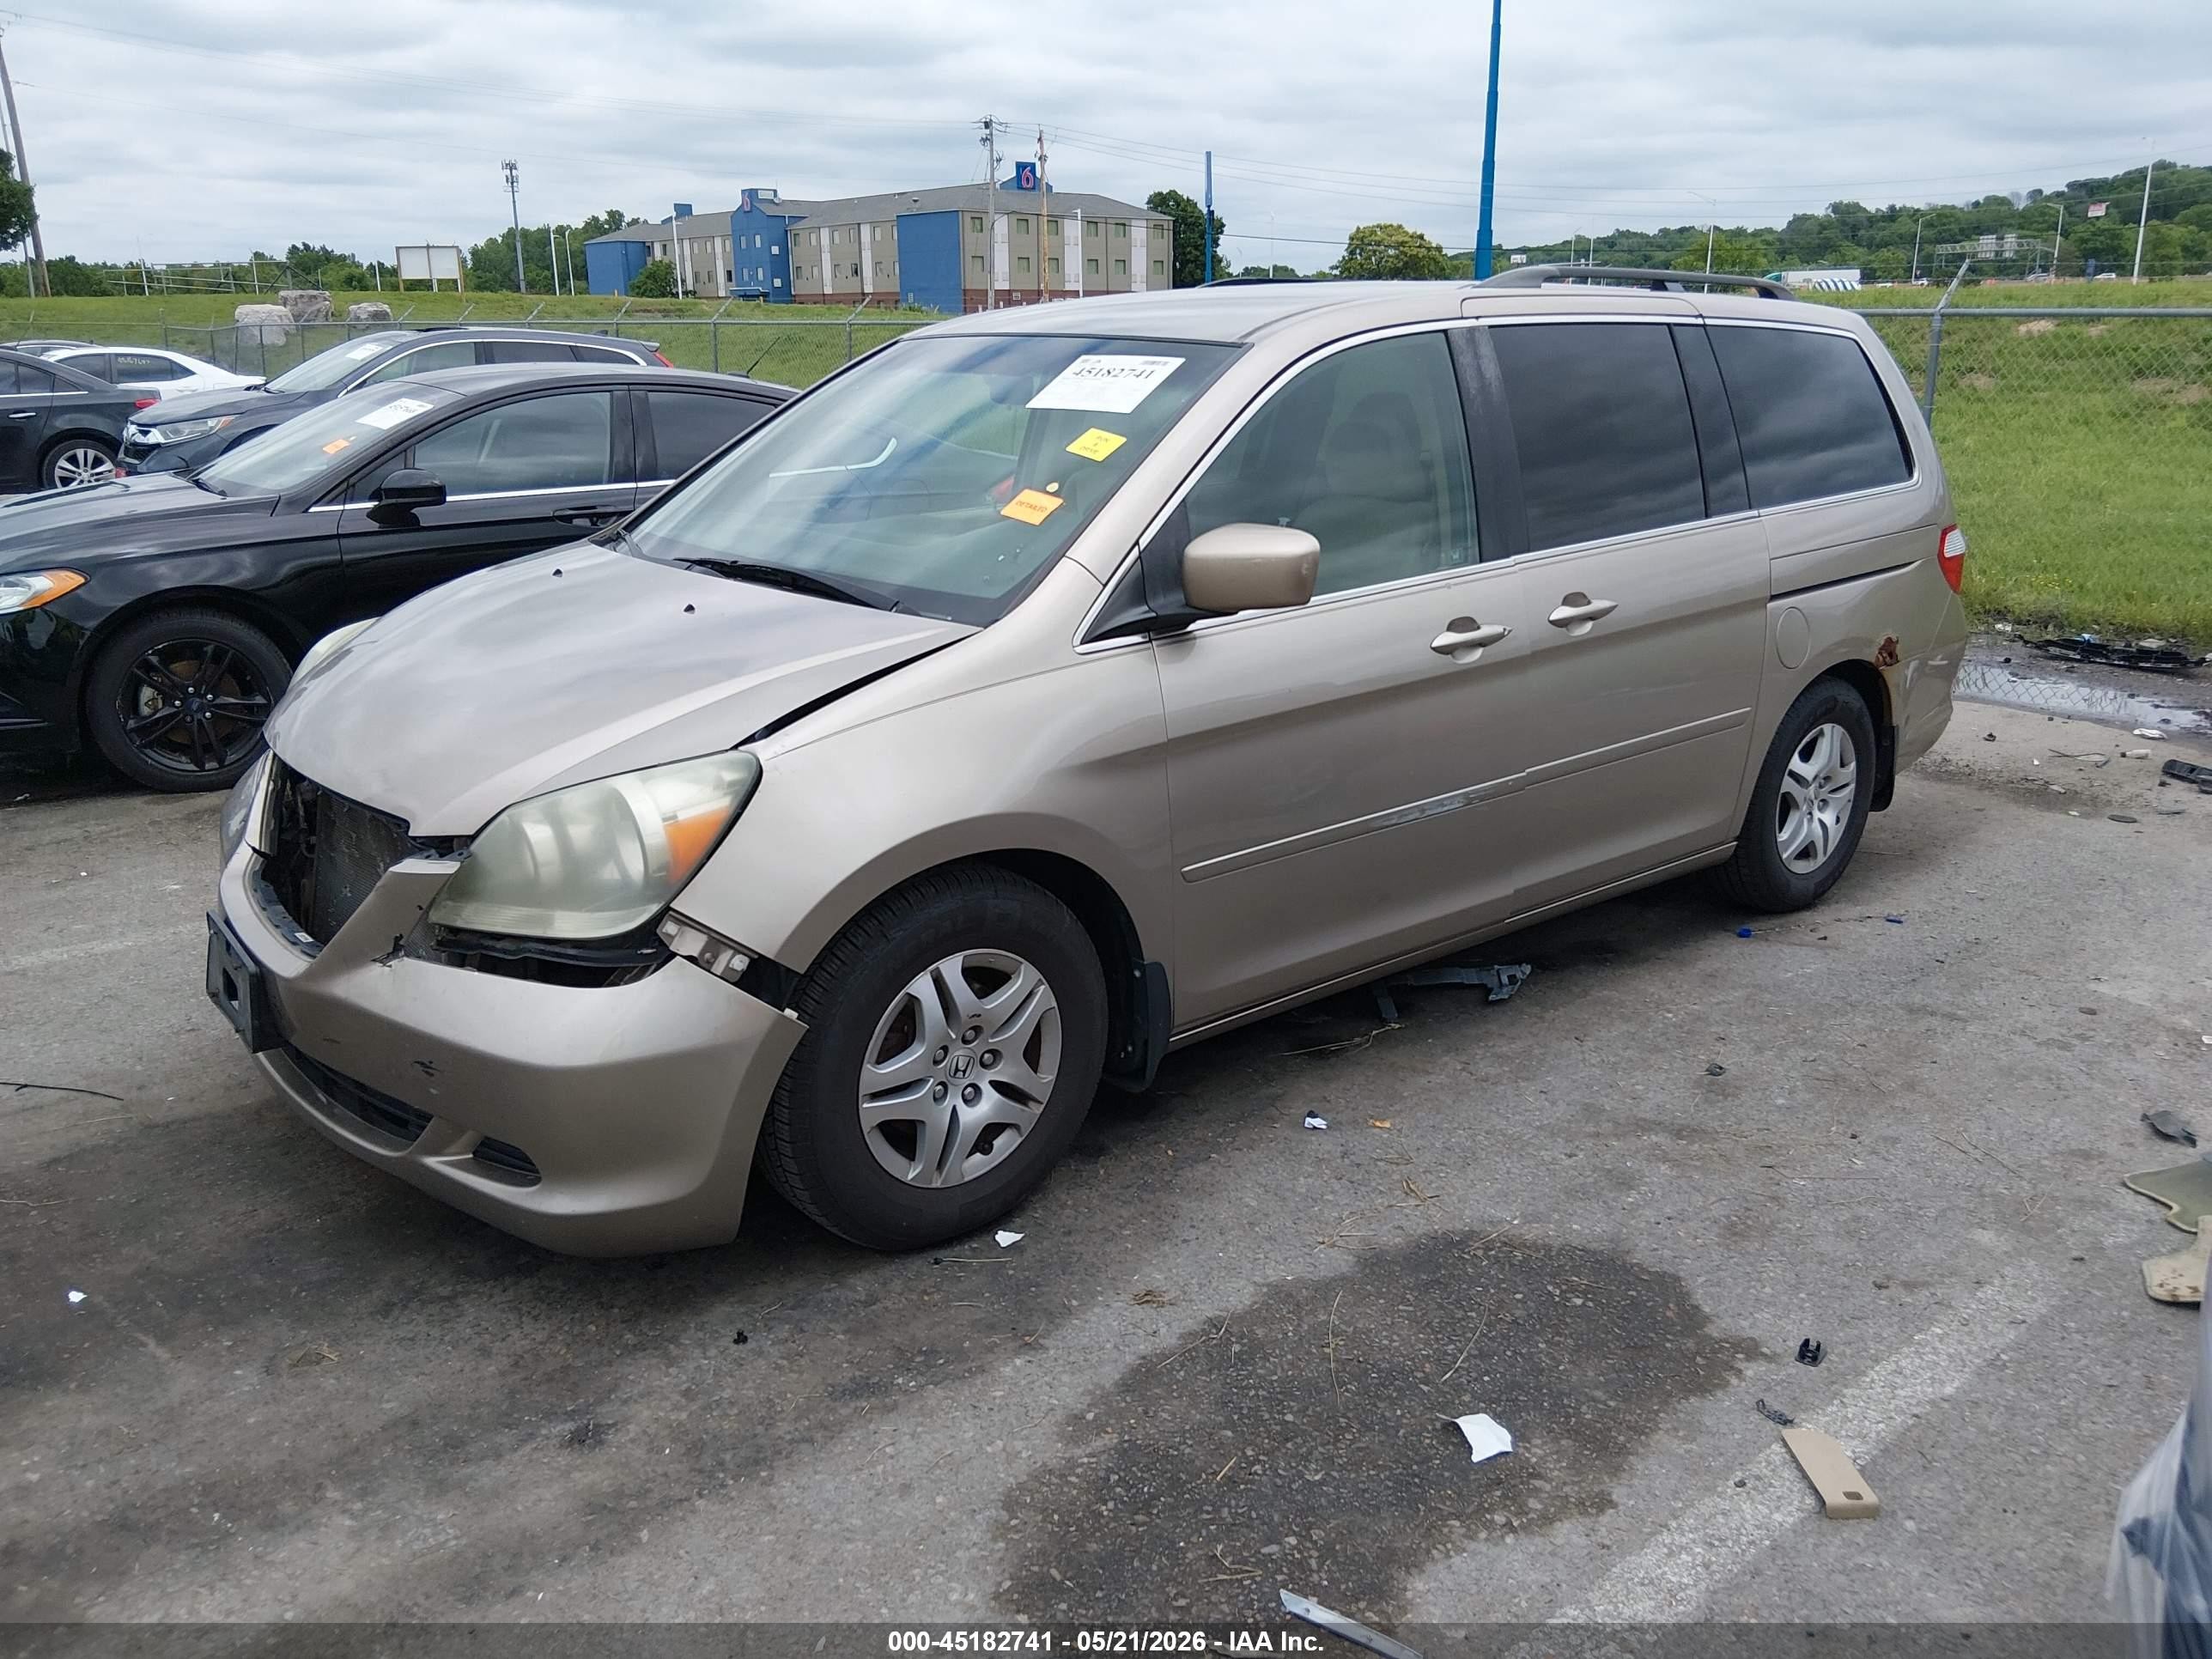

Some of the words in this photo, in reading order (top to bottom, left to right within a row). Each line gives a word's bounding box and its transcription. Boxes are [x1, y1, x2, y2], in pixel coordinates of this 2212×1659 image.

[1022, 167, 1034, 188] 6
[743, 191, 751, 212] 6
[1072, 367, 1156, 380] 45182741
